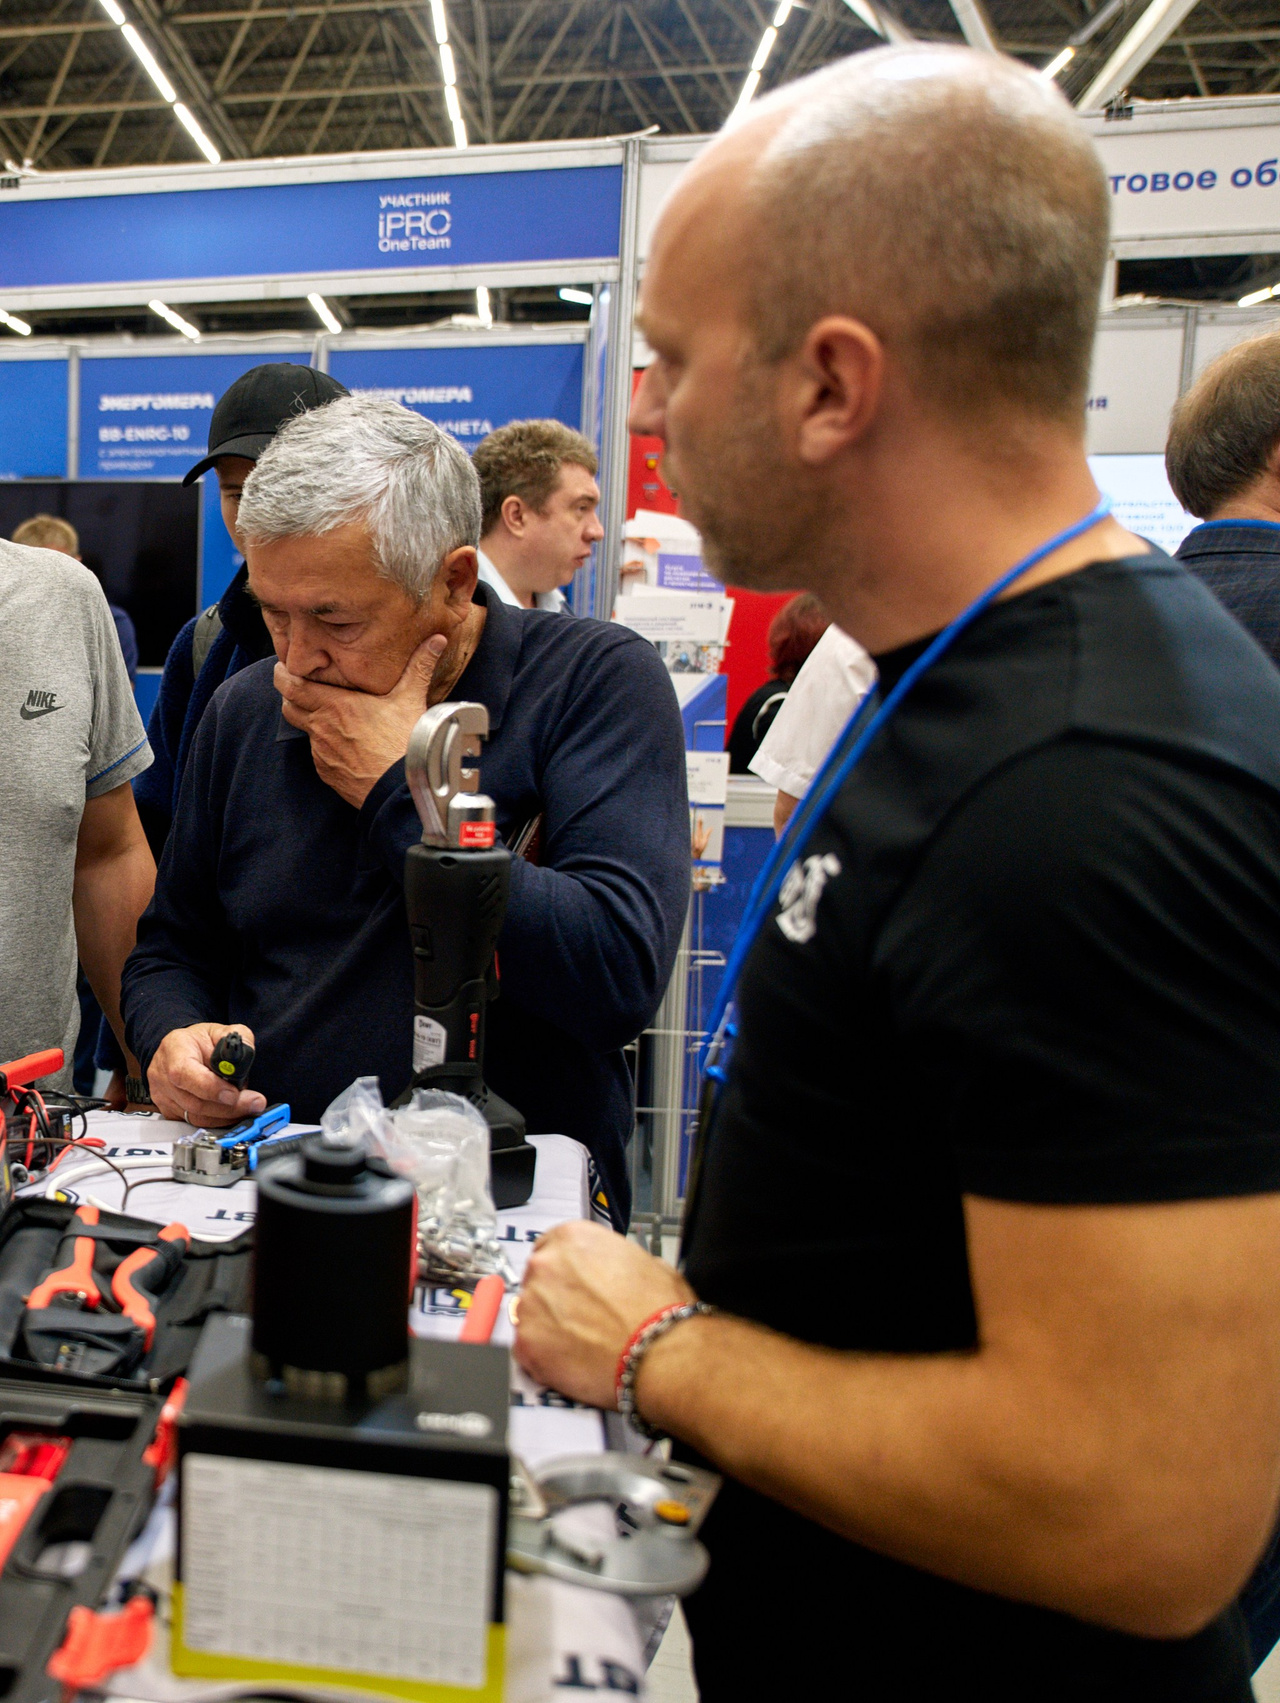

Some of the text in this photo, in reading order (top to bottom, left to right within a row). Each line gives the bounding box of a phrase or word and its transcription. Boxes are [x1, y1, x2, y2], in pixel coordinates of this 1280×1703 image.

[1109, 158, 1280, 194] товое об
[379, 191, 451, 209] УЧАСТНИК
[378, 209, 452, 238] iPRO
[378, 235, 451, 252] OneTeam
[98, 392, 214, 412] ЭНЕРГОМЕРА
[26, 690, 57, 708] NIKE
